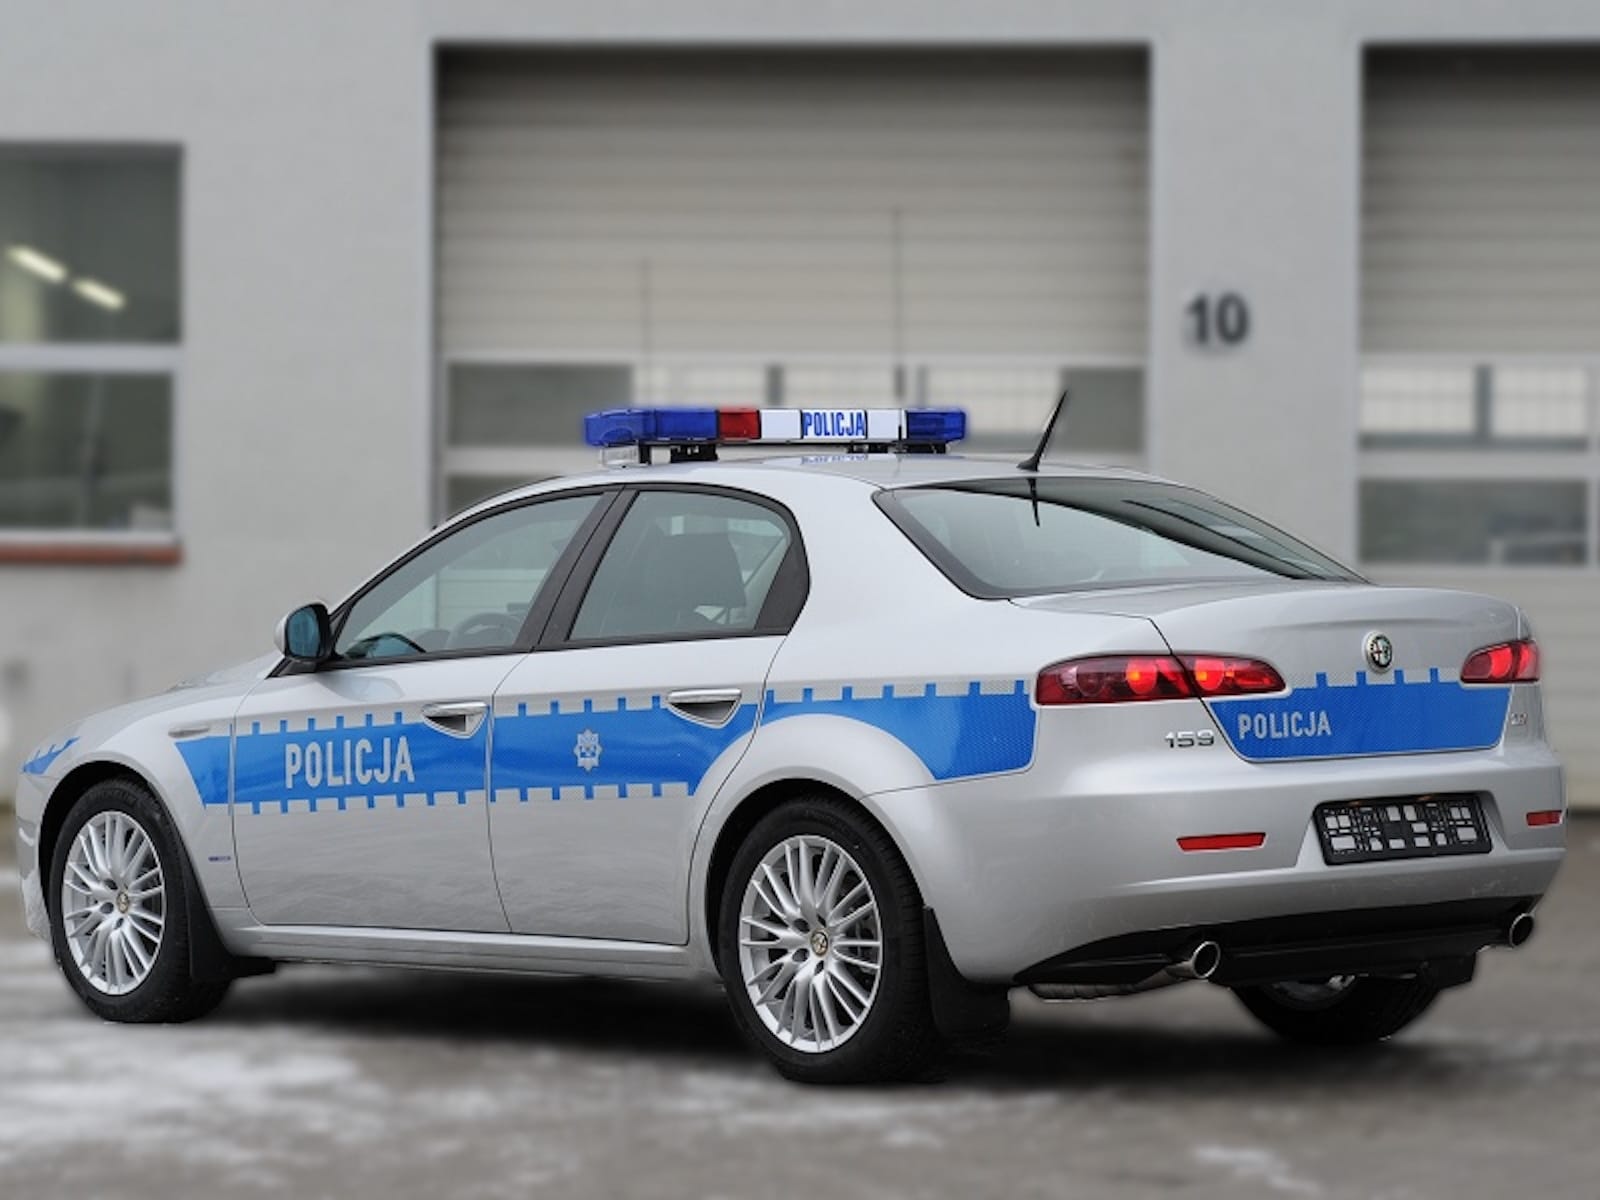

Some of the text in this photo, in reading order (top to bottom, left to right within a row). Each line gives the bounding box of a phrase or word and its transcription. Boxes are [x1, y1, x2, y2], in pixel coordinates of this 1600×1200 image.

[1184, 292, 1249, 346] 10
[803, 412, 865, 436] POLICJA
[1165, 729, 1214, 748] 159
[1238, 710, 1332, 740] POLICJA
[285, 736, 415, 789] POLICJA
